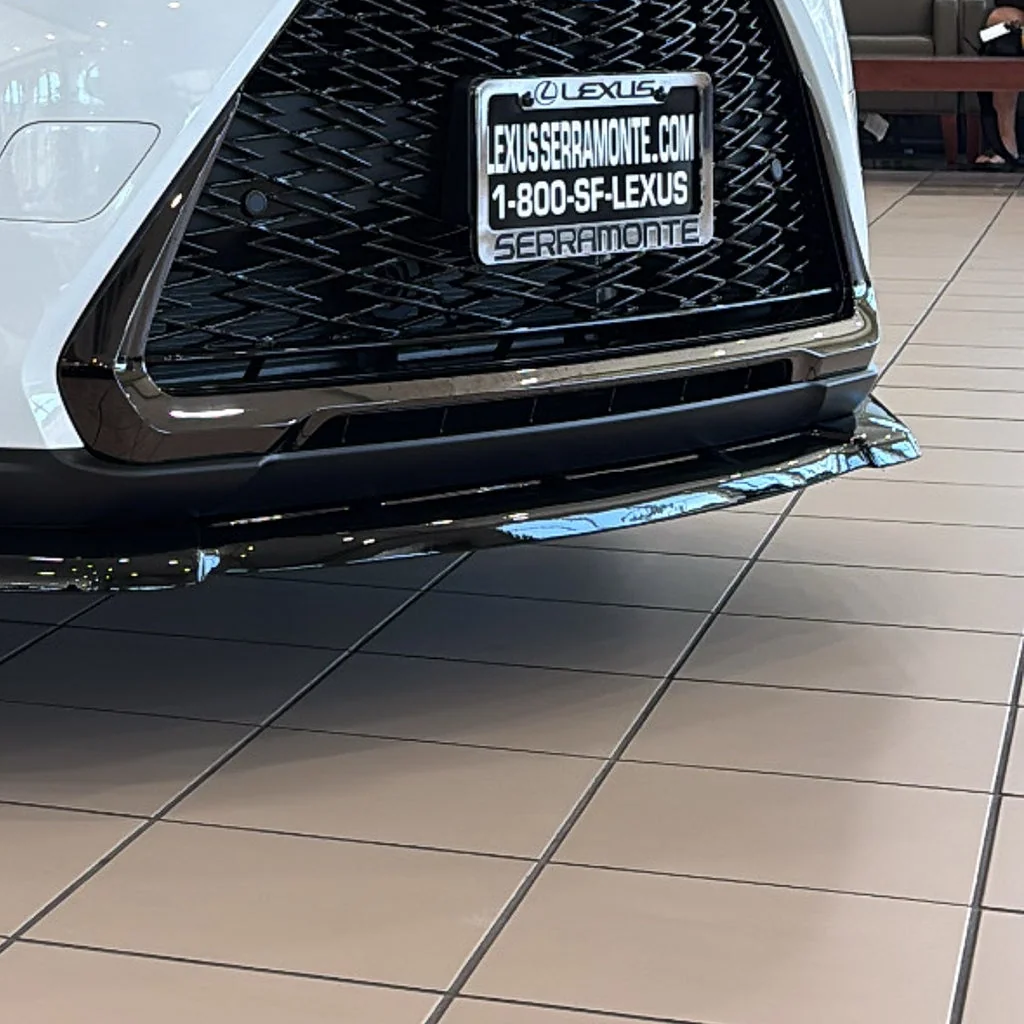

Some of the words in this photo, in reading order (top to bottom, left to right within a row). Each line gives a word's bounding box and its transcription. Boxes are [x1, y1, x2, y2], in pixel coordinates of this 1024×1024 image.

[561, 80, 656, 101] LEXUS
[486, 113, 695, 176] LEXUSSERRAMONTE.COM
[491, 171, 688, 220] 1-800-SF-LEXUS
[493, 217, 700, 262] SERRAMONTE
